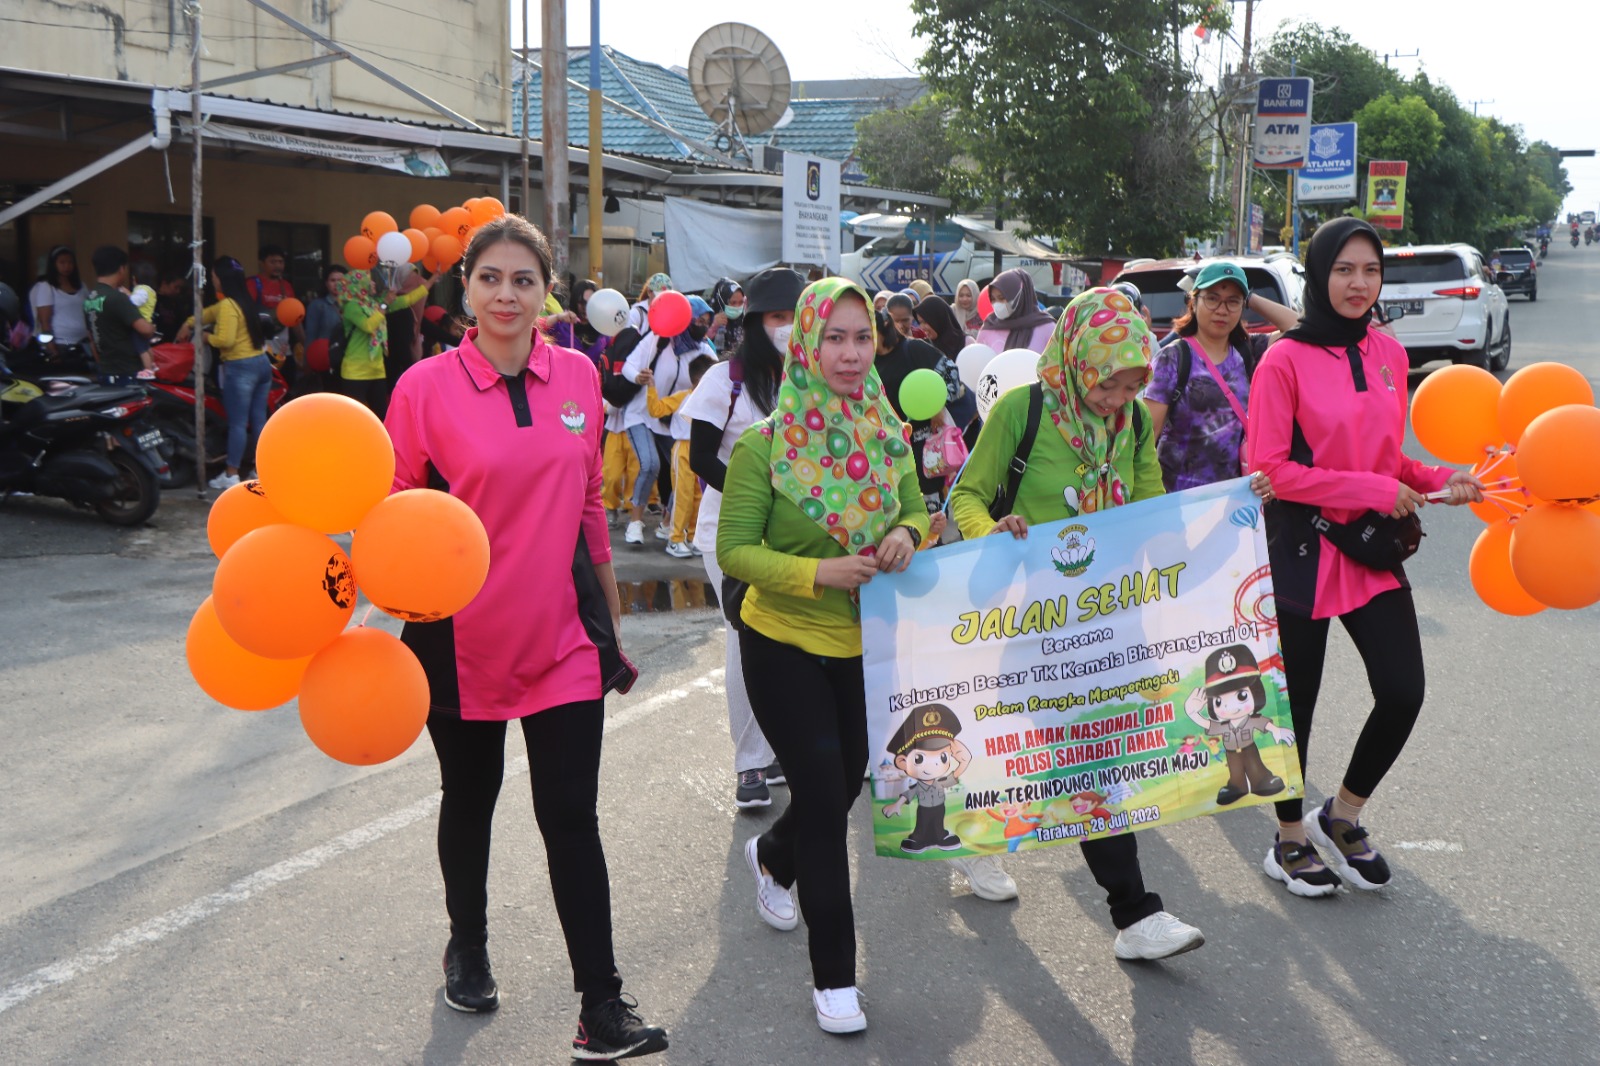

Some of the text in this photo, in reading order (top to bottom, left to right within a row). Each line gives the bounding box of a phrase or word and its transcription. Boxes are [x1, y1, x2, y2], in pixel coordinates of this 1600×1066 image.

[1263, 99, 1304, 107] BANK BRI
[1264, 124, 1299, 135] ATM
[1307, 159, 1352, 168] ATLANTAS
[897, 268, 931, 279] POLS
[951, 562, 1187, 645] JALAN SEHAT
[1042, 628, 1114, 655] Bersama
[889, 621, 1259, 712] Keluarga Besar TK Kemala Bhayangkari 01
[974, 669, 1180, 721] Dalam Rangka Memperingati
[984, 702, 1175, 757] HARI ANAK NASIONAL DAN
[1005, 729, 1168, 777] POLISI SAHABAT ANAK
[965, 751, 1209, 810] ANAK TERLINDUNGI INDONESIA MAJU
[1035, 805, 1160, 842] Tarakan, 28 Juli 2023
